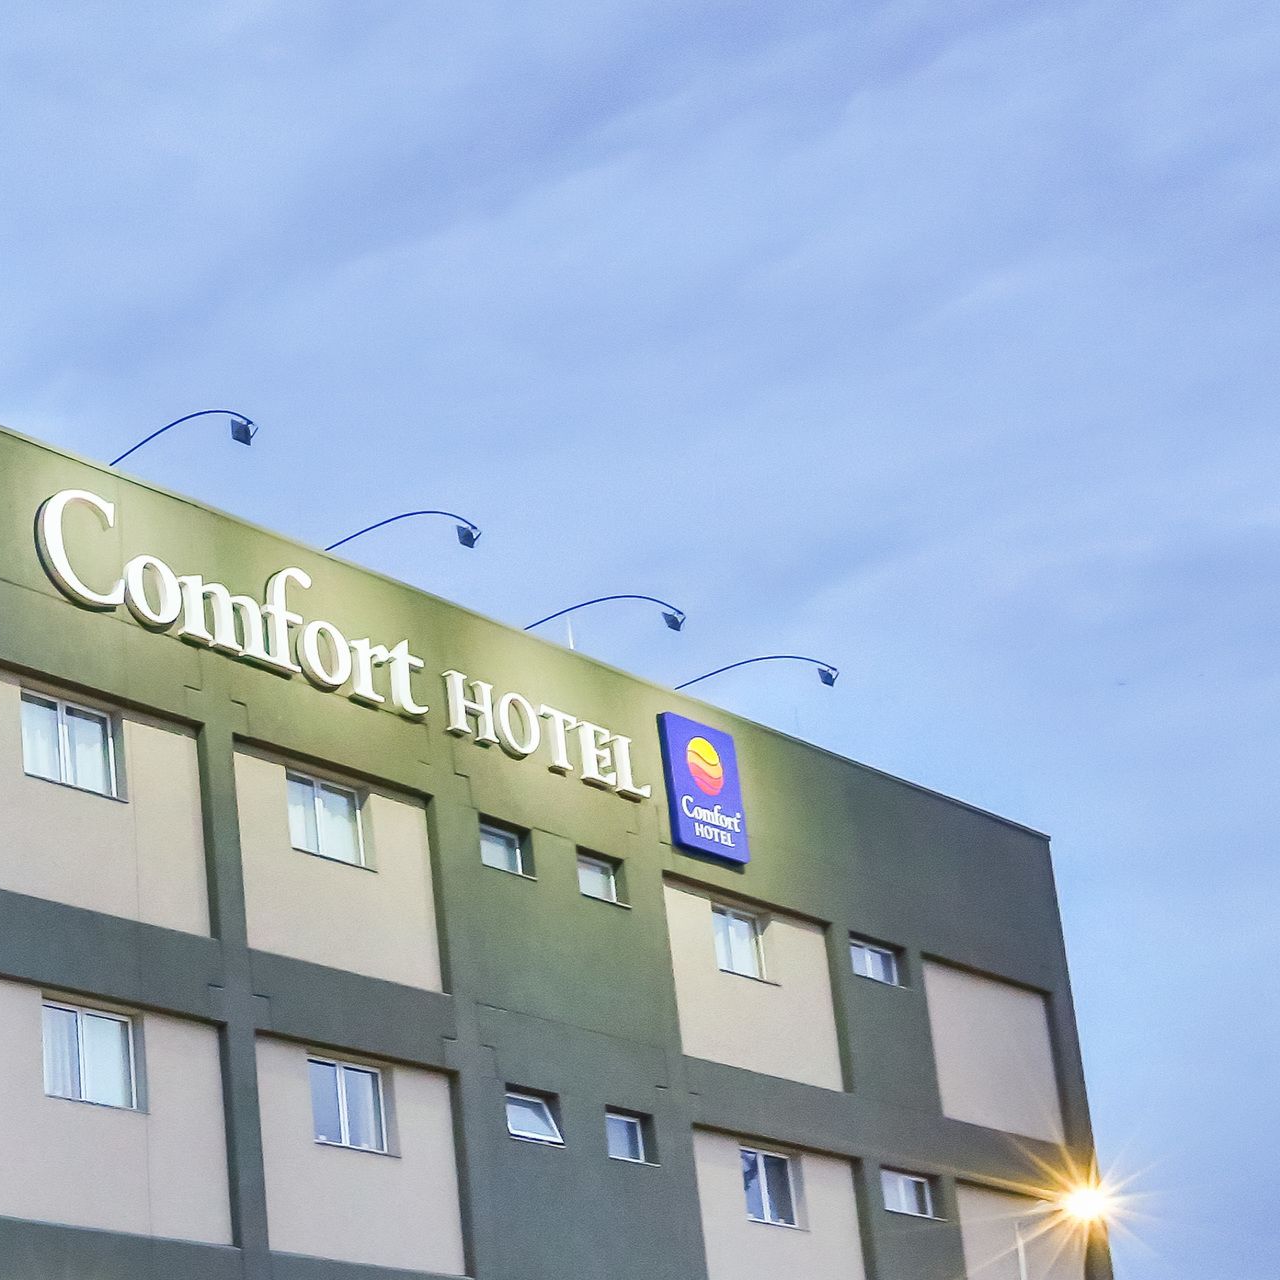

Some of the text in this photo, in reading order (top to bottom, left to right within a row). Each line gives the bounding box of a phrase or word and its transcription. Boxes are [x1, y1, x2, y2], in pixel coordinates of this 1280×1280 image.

[36, 489, 651, 799] Comfort HOTEL
[681, 794, 741, 833] Comfort
[694, 822, 736, 847] HOTEL
